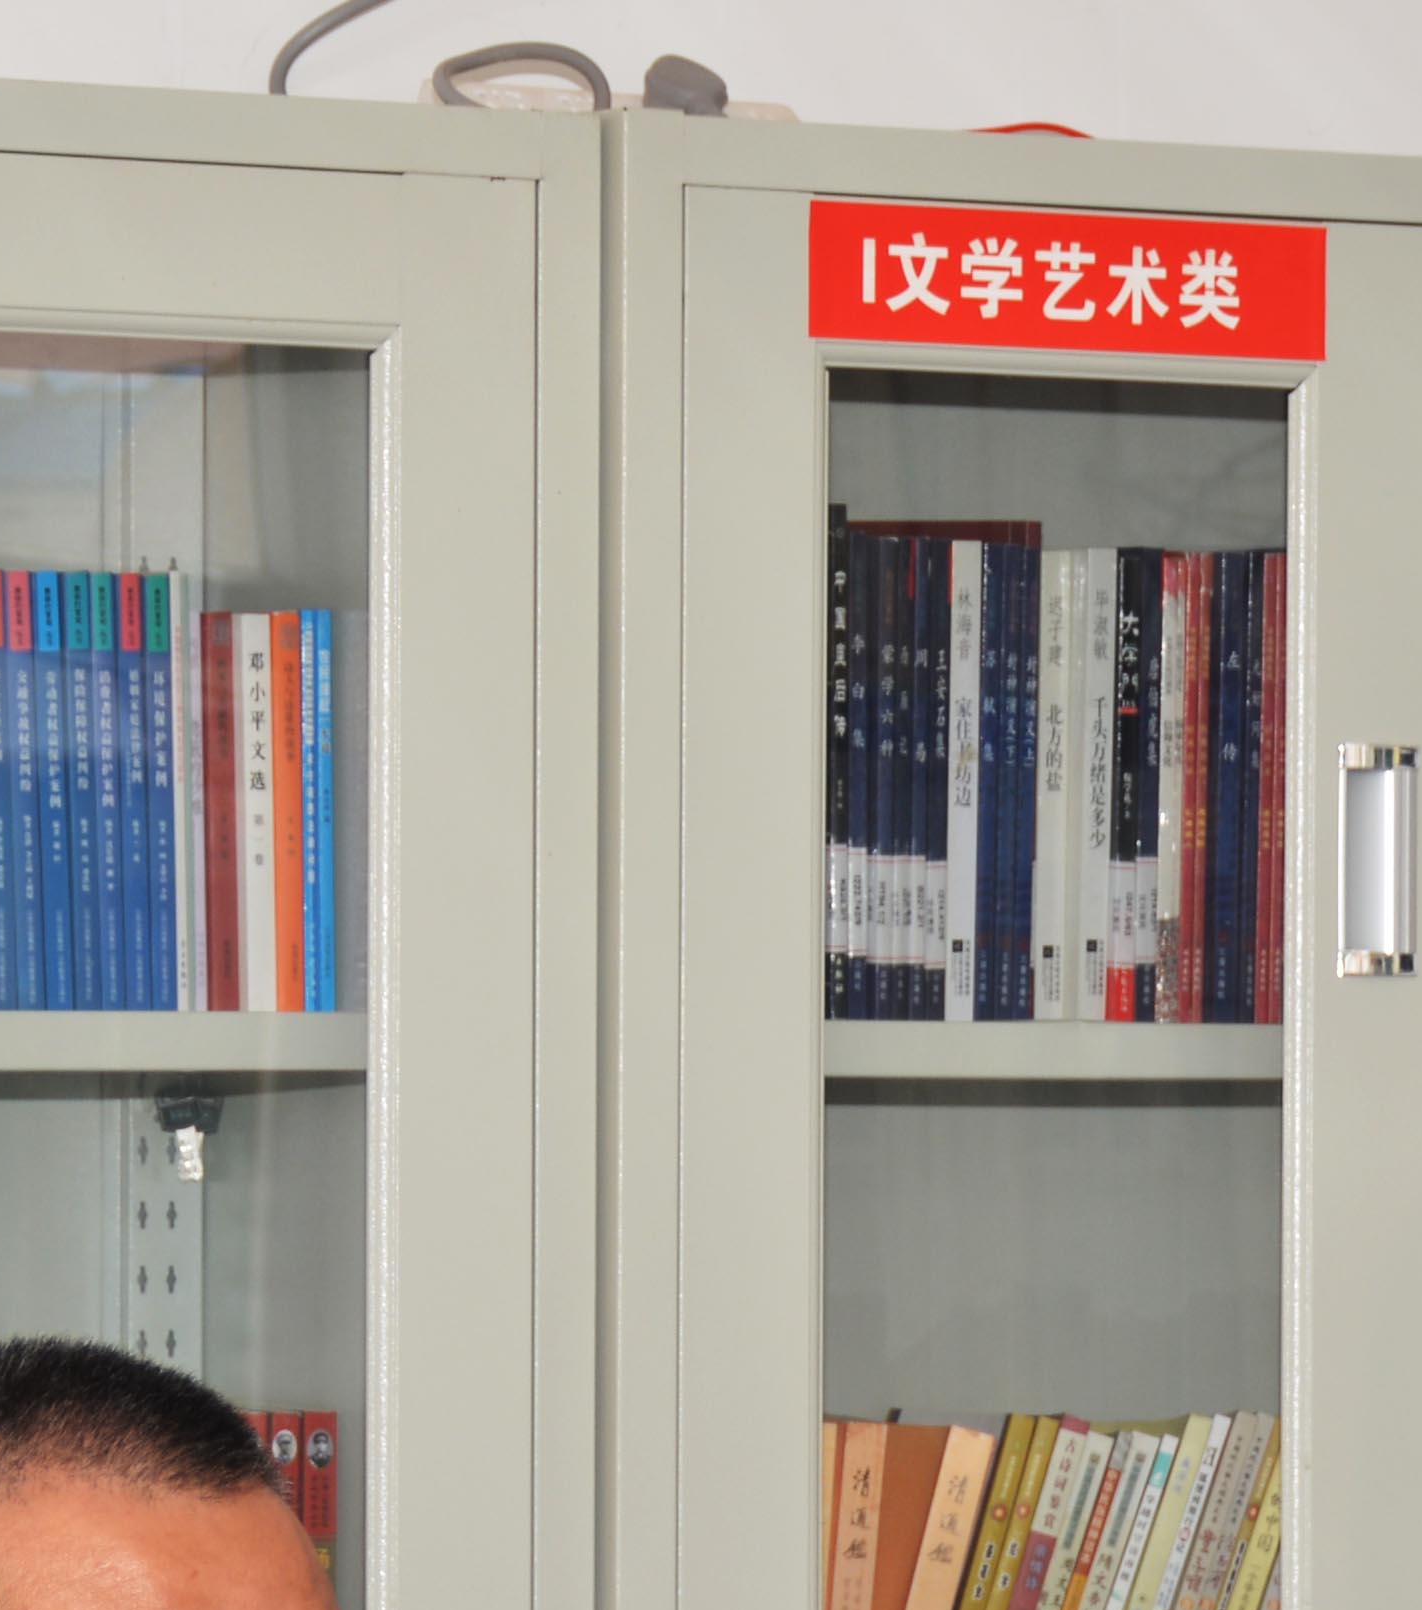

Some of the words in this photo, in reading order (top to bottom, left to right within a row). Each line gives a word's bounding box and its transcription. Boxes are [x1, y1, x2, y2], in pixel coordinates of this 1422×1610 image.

[862, 232, 1240, 330] I文学艺术类
[956, 586, 973, 660] 林海音
[248, 652, 266, 792] 邓小平文选
